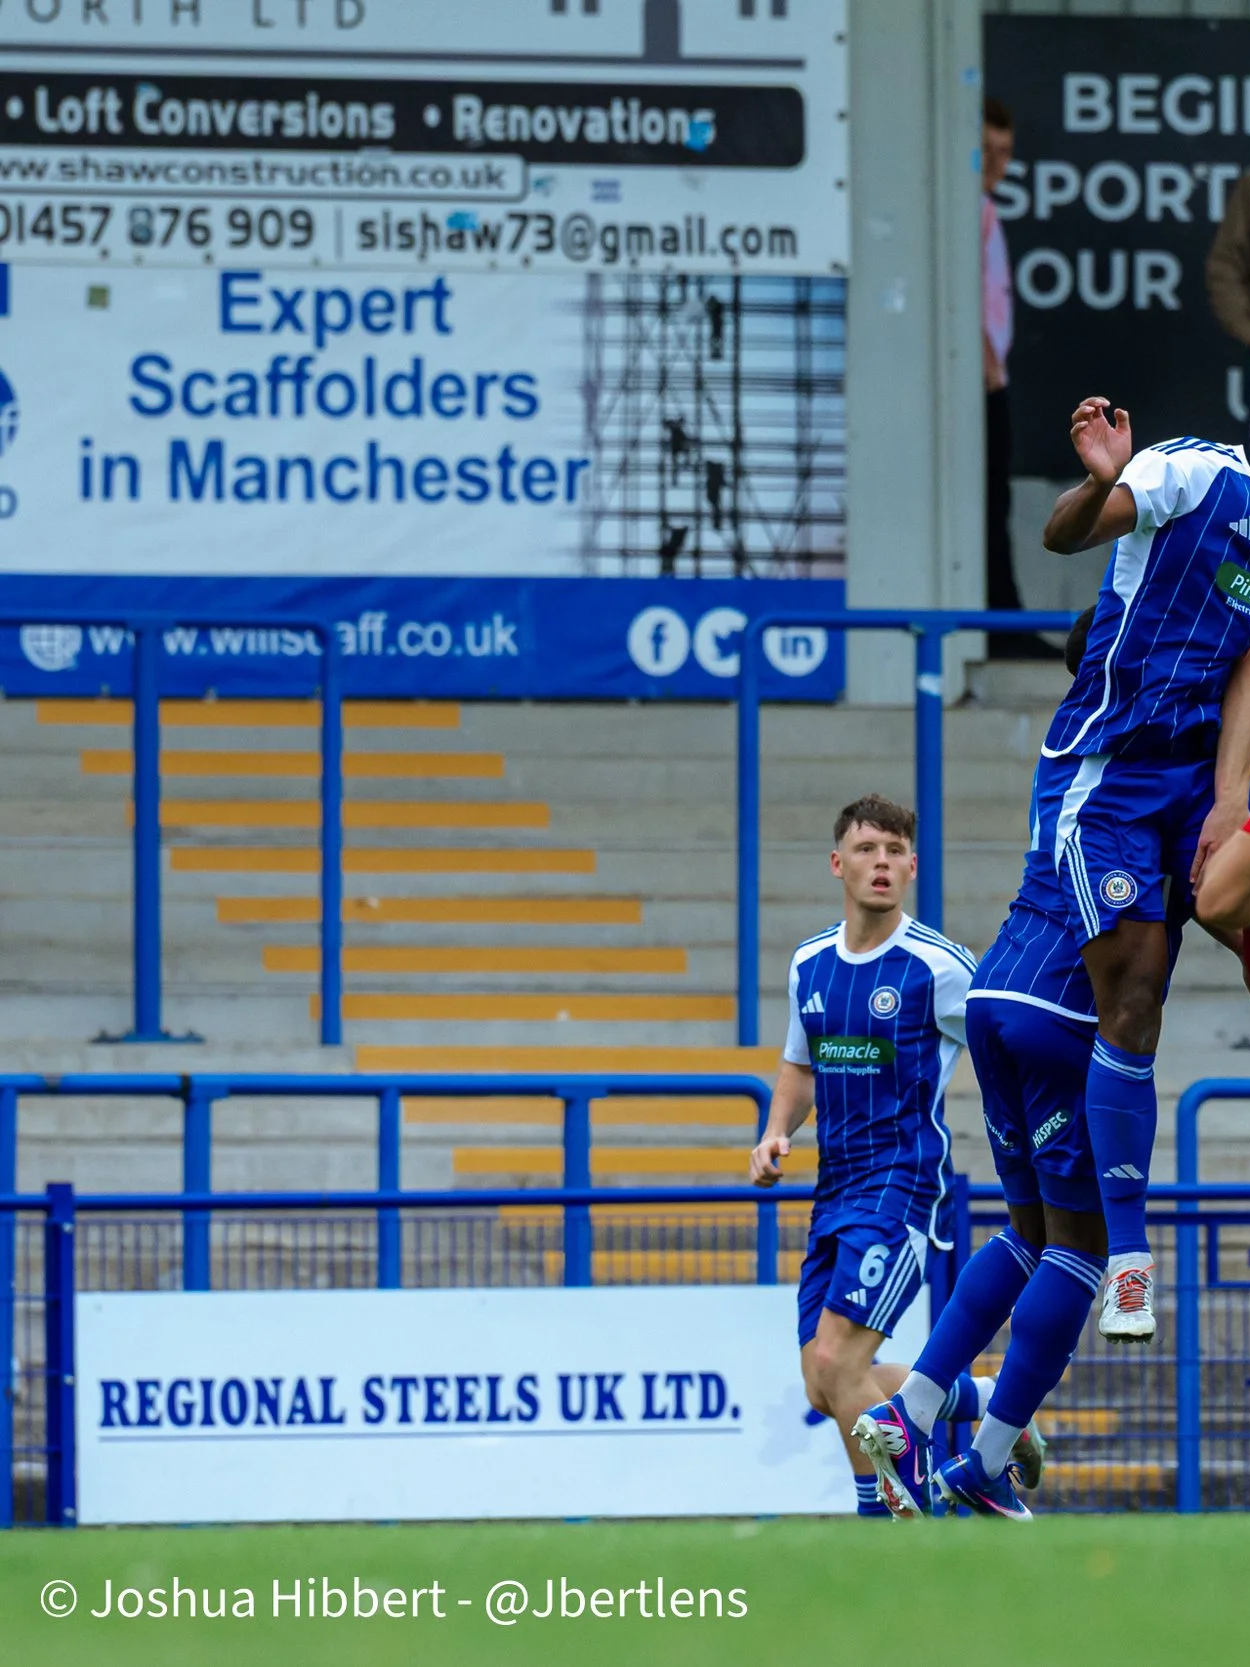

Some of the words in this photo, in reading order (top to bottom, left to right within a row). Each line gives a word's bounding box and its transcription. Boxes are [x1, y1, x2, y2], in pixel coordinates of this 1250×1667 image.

[35, 86, 123, 134] Loft
[133, 86, 397, 139] Conversions
[995, 160, 1239, 223] SPORT
[127, 206, 213, 248] 876
[226, 207, 316, 250] 909
[1015, 248, 1183, 310] OUR
[218, 270, 454, 350] Expert
[128, 352, 541, 420] Scaffolders
[80, 436, 141, 502] in
[168, 437, 593, 503] Manchester
[819, 1042, 880, 1059] Pinnacle
[859, 1244, 890, 1288] 6
[99, 1376, 346, 1428] REGIONAL
[362, 1373, 540, 1425] STEELS
[557, 1373, 625, 1423] UK
[641, 1371, 742, 1421] LTD.
